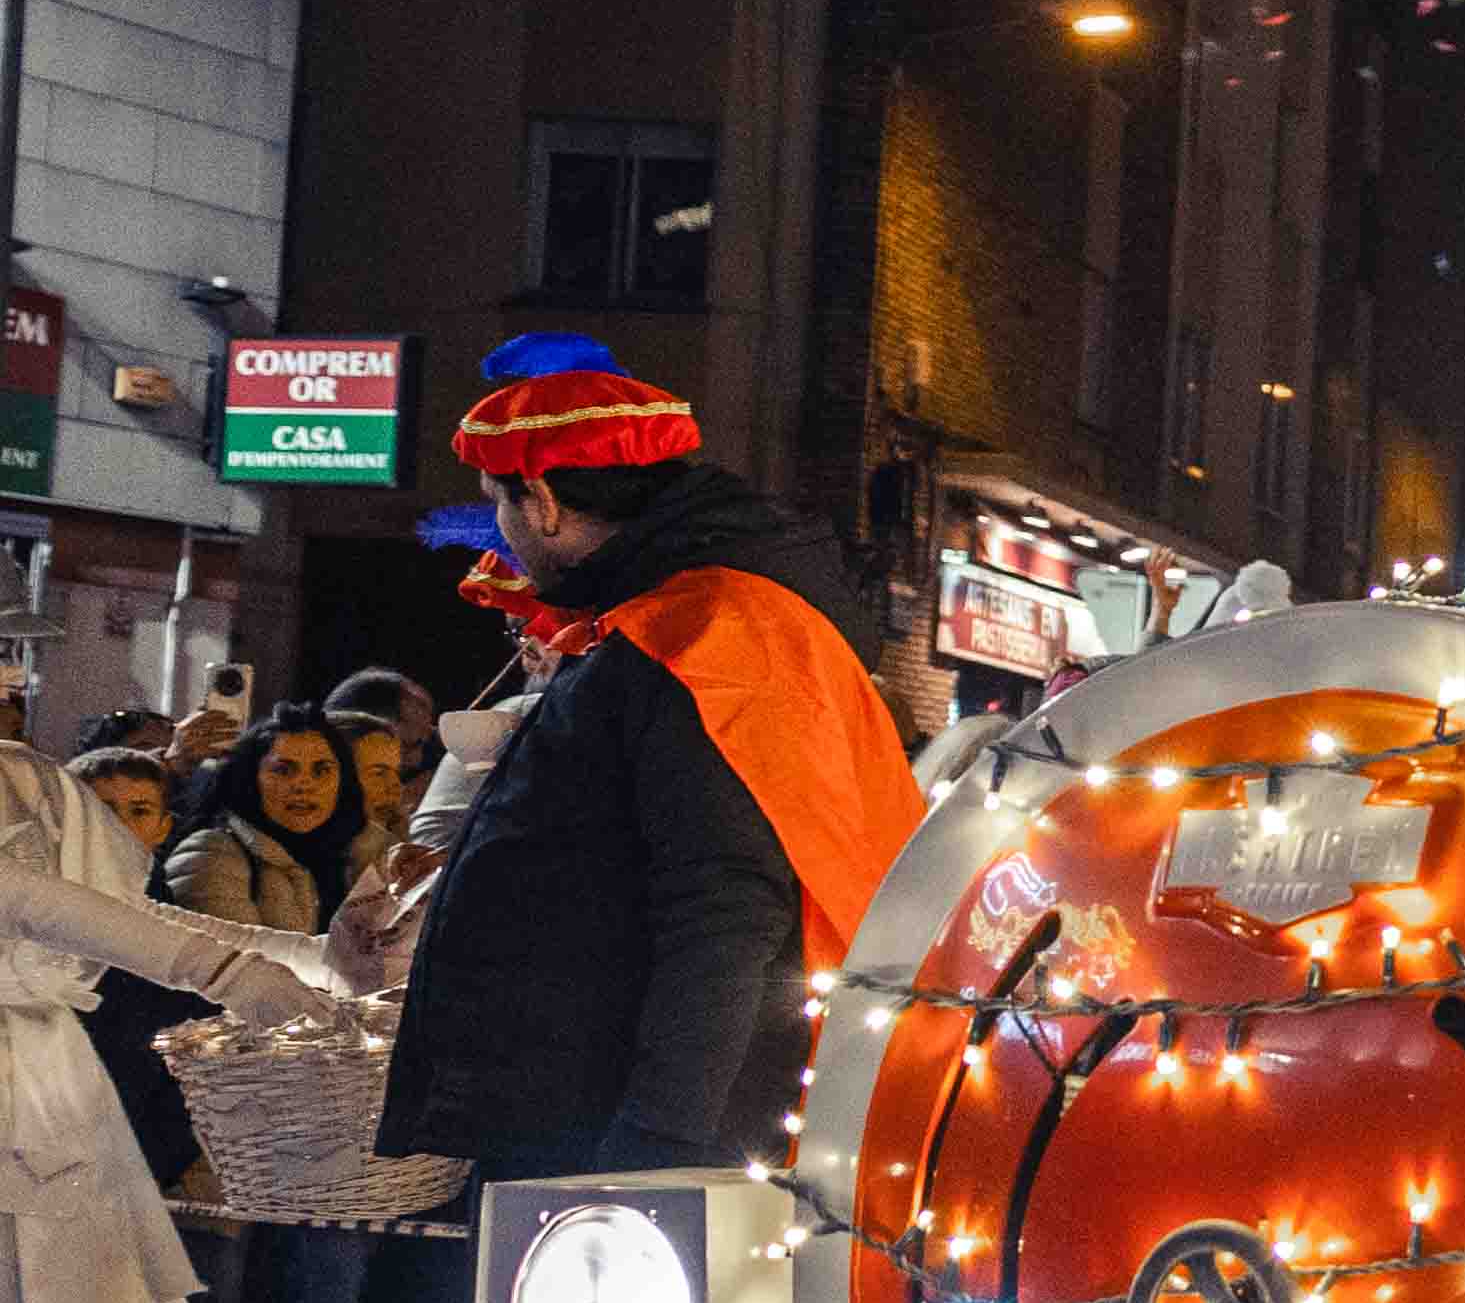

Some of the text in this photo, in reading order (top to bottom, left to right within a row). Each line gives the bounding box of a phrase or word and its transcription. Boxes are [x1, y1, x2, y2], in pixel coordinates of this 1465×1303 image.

[235, 350, 395, 377] COMPREM
[288, 376, 337, 402] OR
[272, 425, 347, 450] CASA
